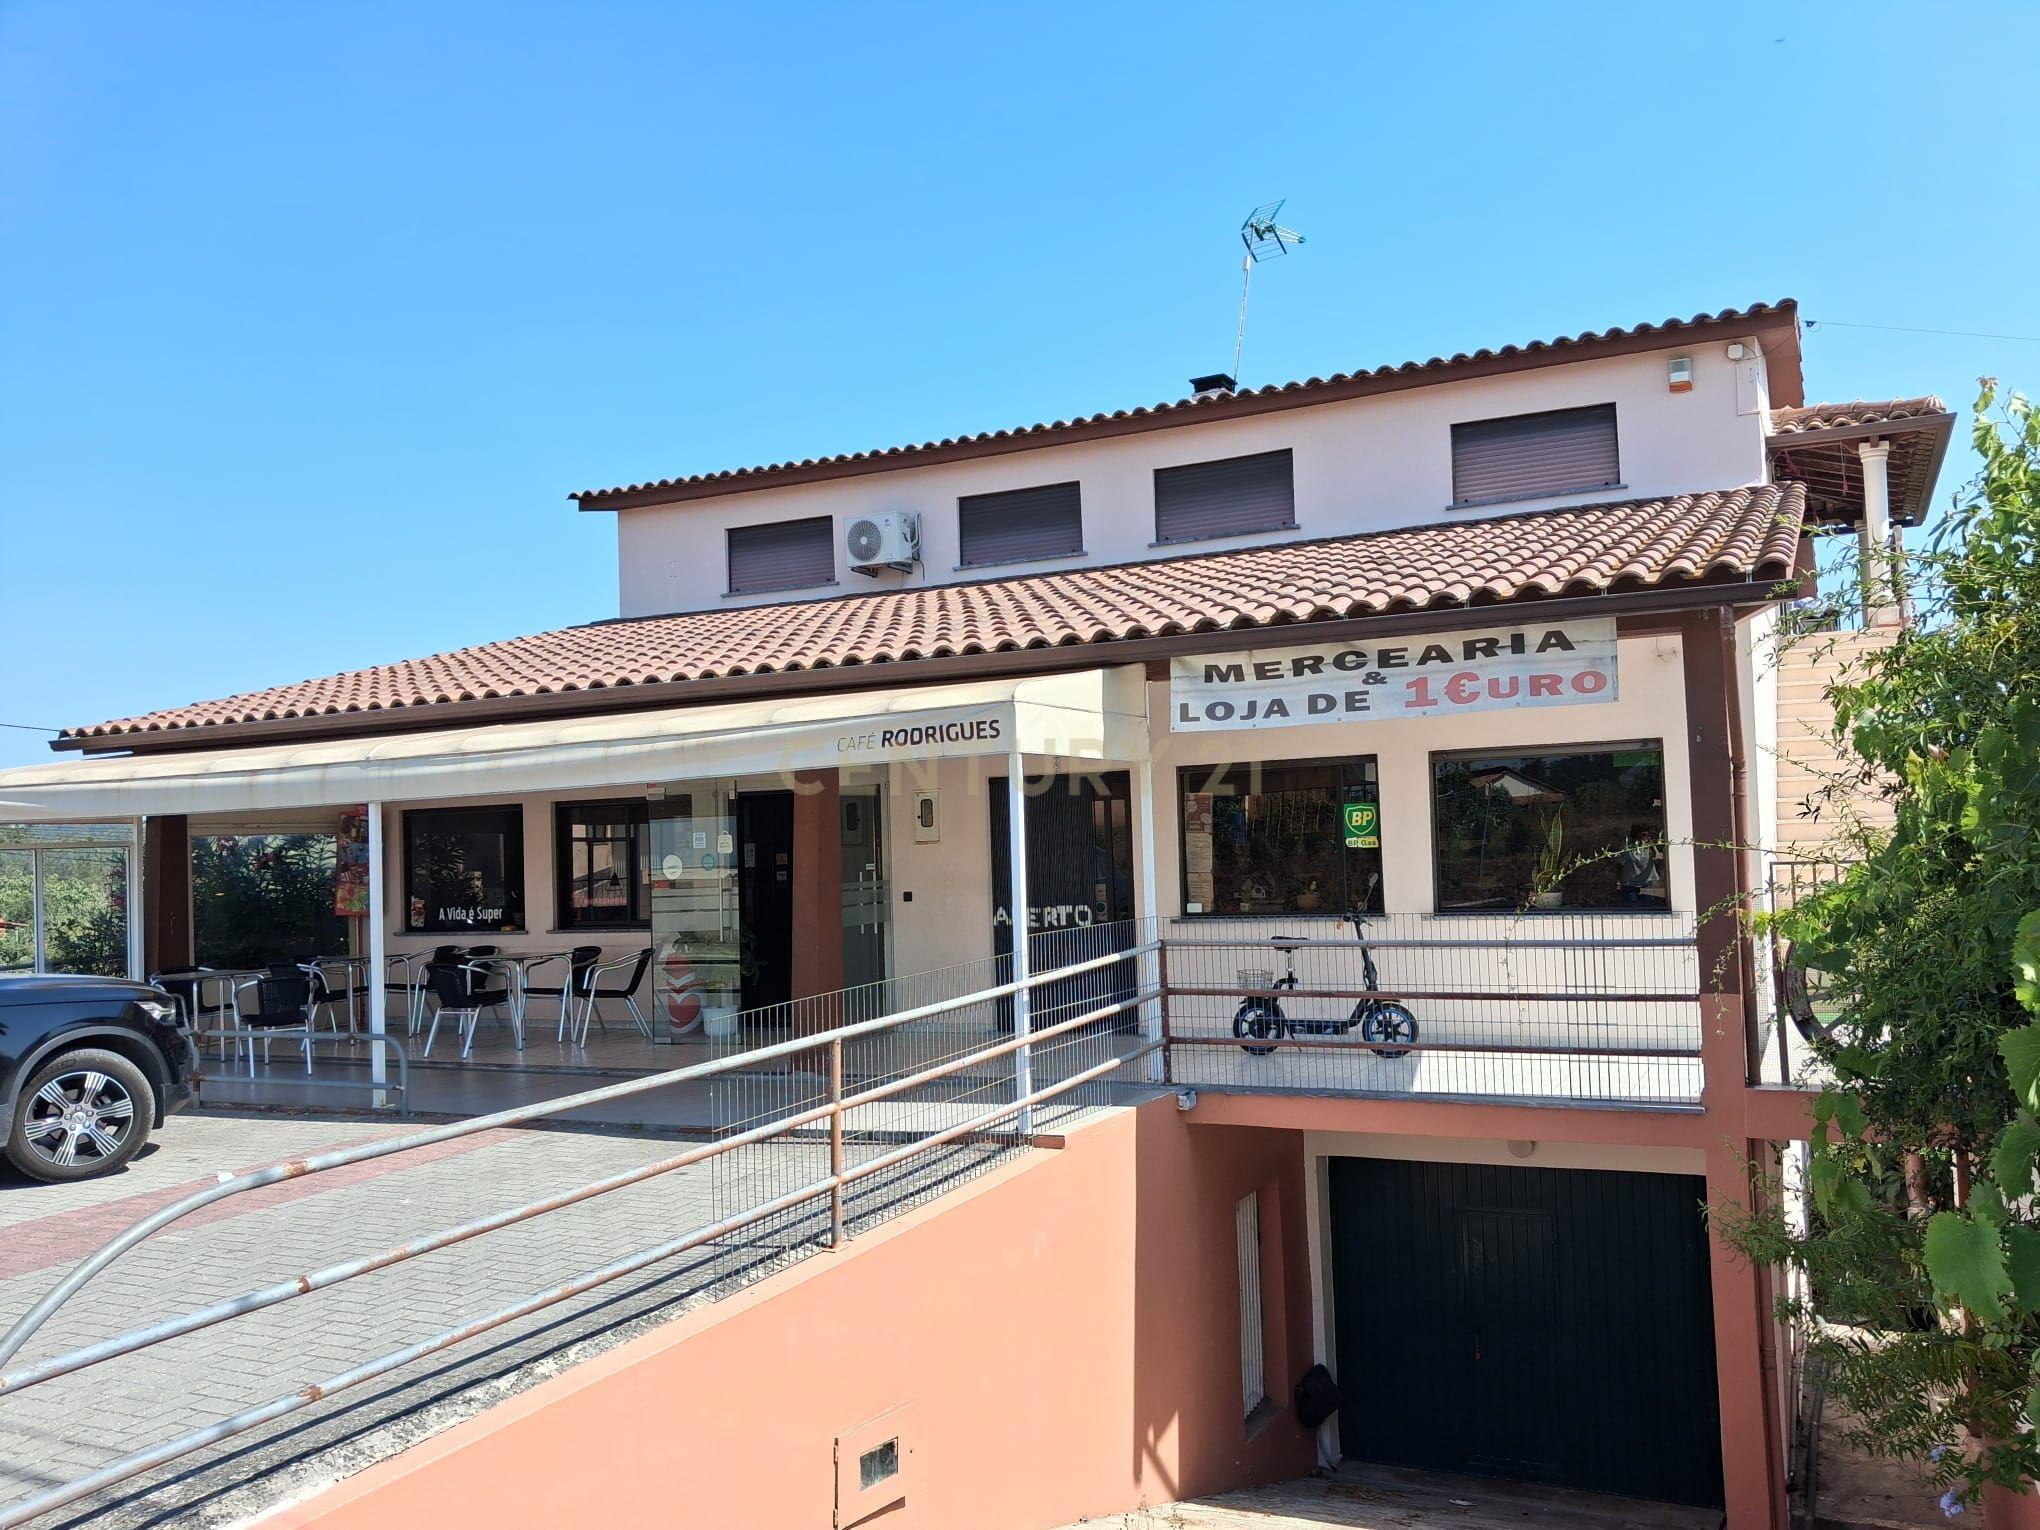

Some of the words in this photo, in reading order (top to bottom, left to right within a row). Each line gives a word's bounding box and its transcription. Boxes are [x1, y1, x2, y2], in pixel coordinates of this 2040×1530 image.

[1203, 630, 1576, 684] MERCEARIA
[1361, 671, 1388, 687] &
[1179, 698, 1290, 723] LOJA
[1307, 690, 1371, 714] DE
[837, 732, 876, 752] CAFÉ
[881, 720, 1000, 748] RODRIGUES
[1351, 811, 1372, 826] BP
[439, 908, 445, 920] A
[447, 907, 466, 920] Vida
[468, 907, 474, 919] é
[477, 906, 503, 923] Super
[993, 905, 1092, 927] AERTO
